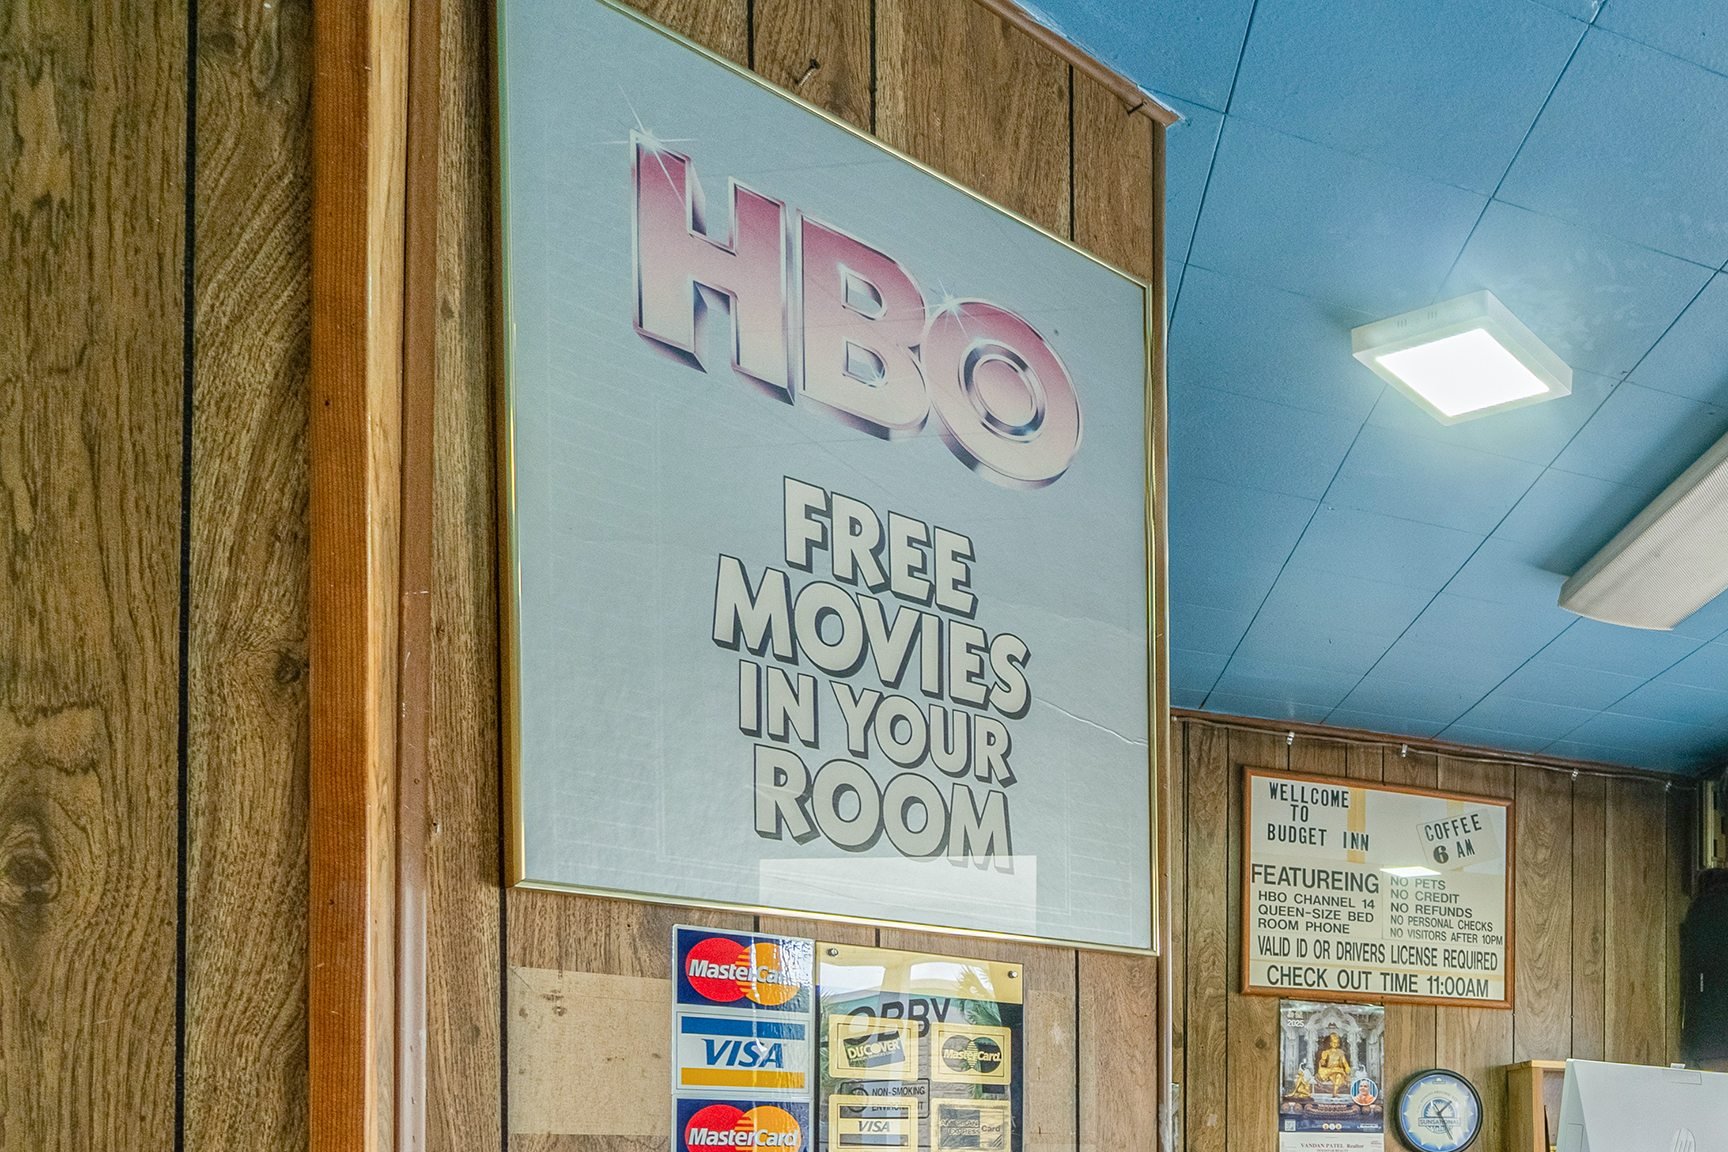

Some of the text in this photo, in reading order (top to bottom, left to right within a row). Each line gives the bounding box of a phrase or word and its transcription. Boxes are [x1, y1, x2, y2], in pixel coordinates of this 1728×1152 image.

[629, 129, 1083, 490] HBO
[783, 475, 978, 616] FREE
[712, 553, 1031, 721] MOVIES
[738, 659, 1018, 788] IN YOUR
[1269, 782, 1349, 808] WELLCOME
[753, 743, 1015, 874] ROOM
[1290, 804, 1309, 822] TO
[1267, 823, 1369, 851] BUDGET INN
[1424, 813, 1482, 842] COFFEE
[1433, 838, 1475, 864] 6 AM
[1251, 863, 1379, 894] FEATUREING
[1390, 876, 1446, 890] NO PETS
[1258, 891, 1375, 909] HBO CHANNEL 14
[1390, 889, 1459, 904] NO CREDIT
[1258, 904, 1374, 923] QUEEN-SIZE BED
[1390, 902, 1473, 918] NO REFUNDS
[1258, 918, 1350, 934] ROOM PHONE
[1390, 915, 1493, 932] NO PERSONAL CHECKS
[1390, 927, 1503, 945] NO VISITORS AFTER 10PM
[1258, 935, 1498, 971] VALID ID OR DRIVERS LICENSE REQUIRED
[1267, 965, 1489, 998] CHECK OUT TIME 11:00AM
[701, 1037, 785, 1069] VISA
[847, 1039, 901, 1059] DISCOVER
[943, 1048, 1002, 1064] MasterCard
[872, 1086, 926, 1097] NON-SMOKING
[687, 1126, 799, 1148] MasterCard
[857, 1120, 891, 1133] VISA
[981, 1124, 1001, 1134] Card
